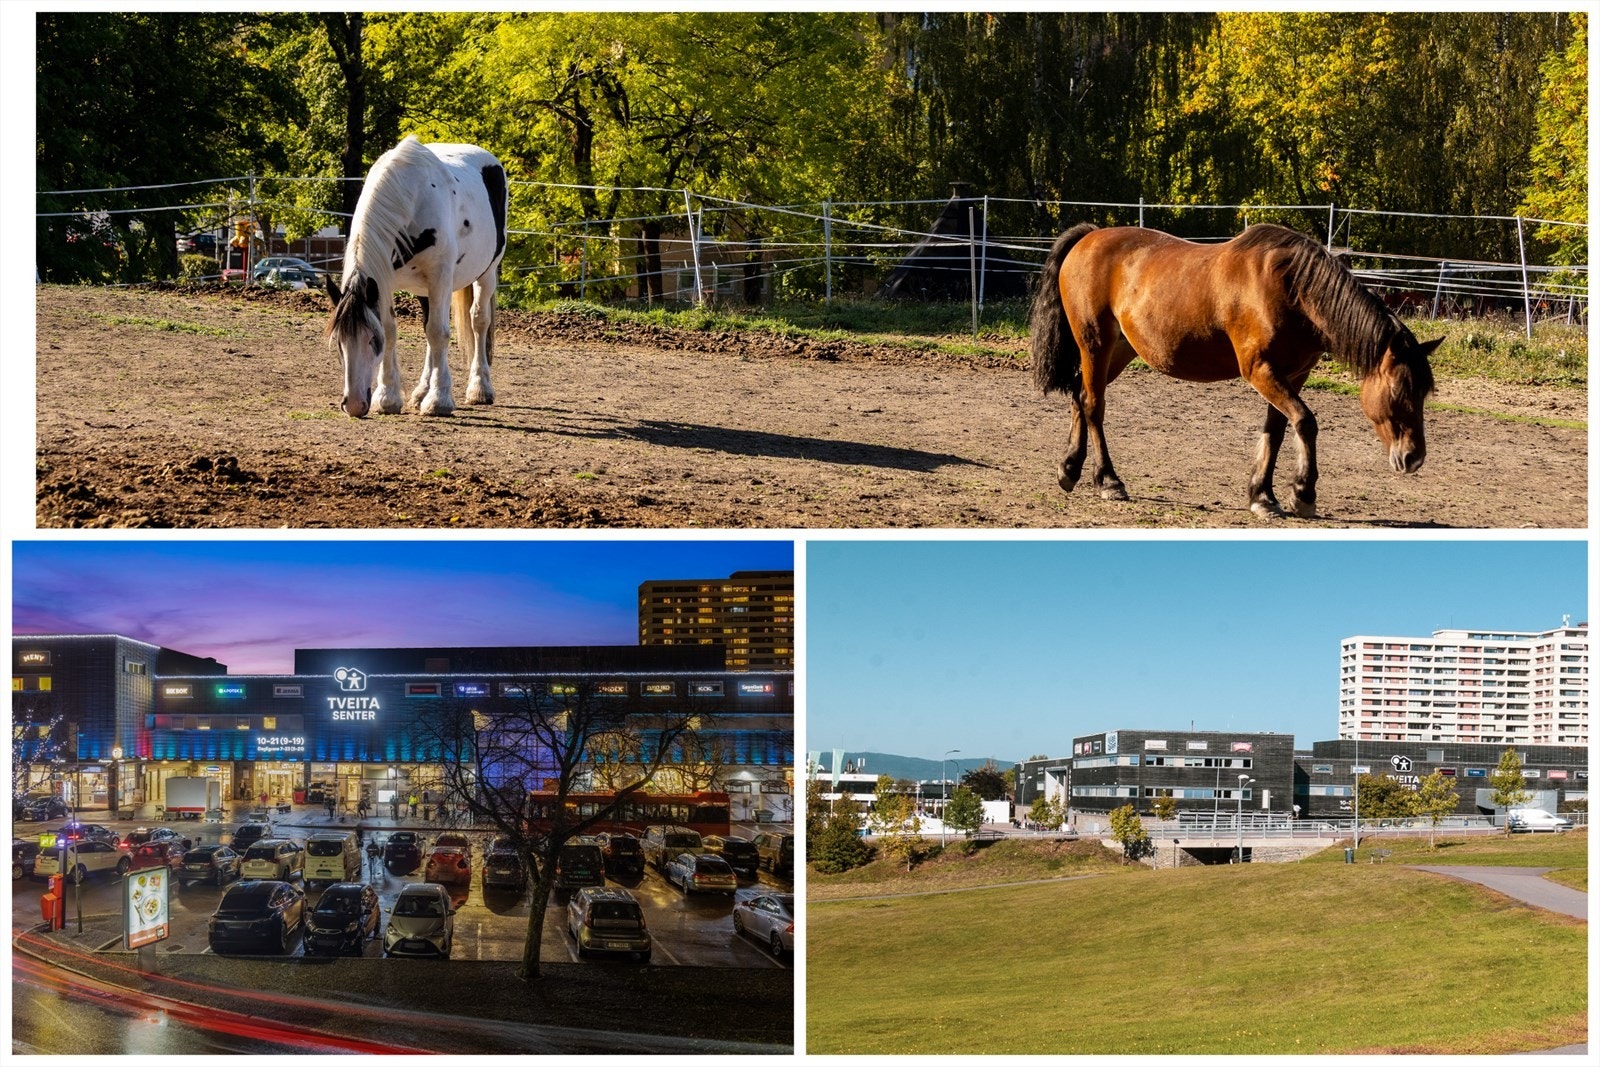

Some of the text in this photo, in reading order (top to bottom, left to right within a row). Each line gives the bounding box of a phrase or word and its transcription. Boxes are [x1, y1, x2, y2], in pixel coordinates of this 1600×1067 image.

[23, 653, 45, 662] MENY
[327, 696, 380, 710] TVEITA
[332, 710, 375, 720] SENTER
[256, 736, 305, 746] 10-21 (9-19)
